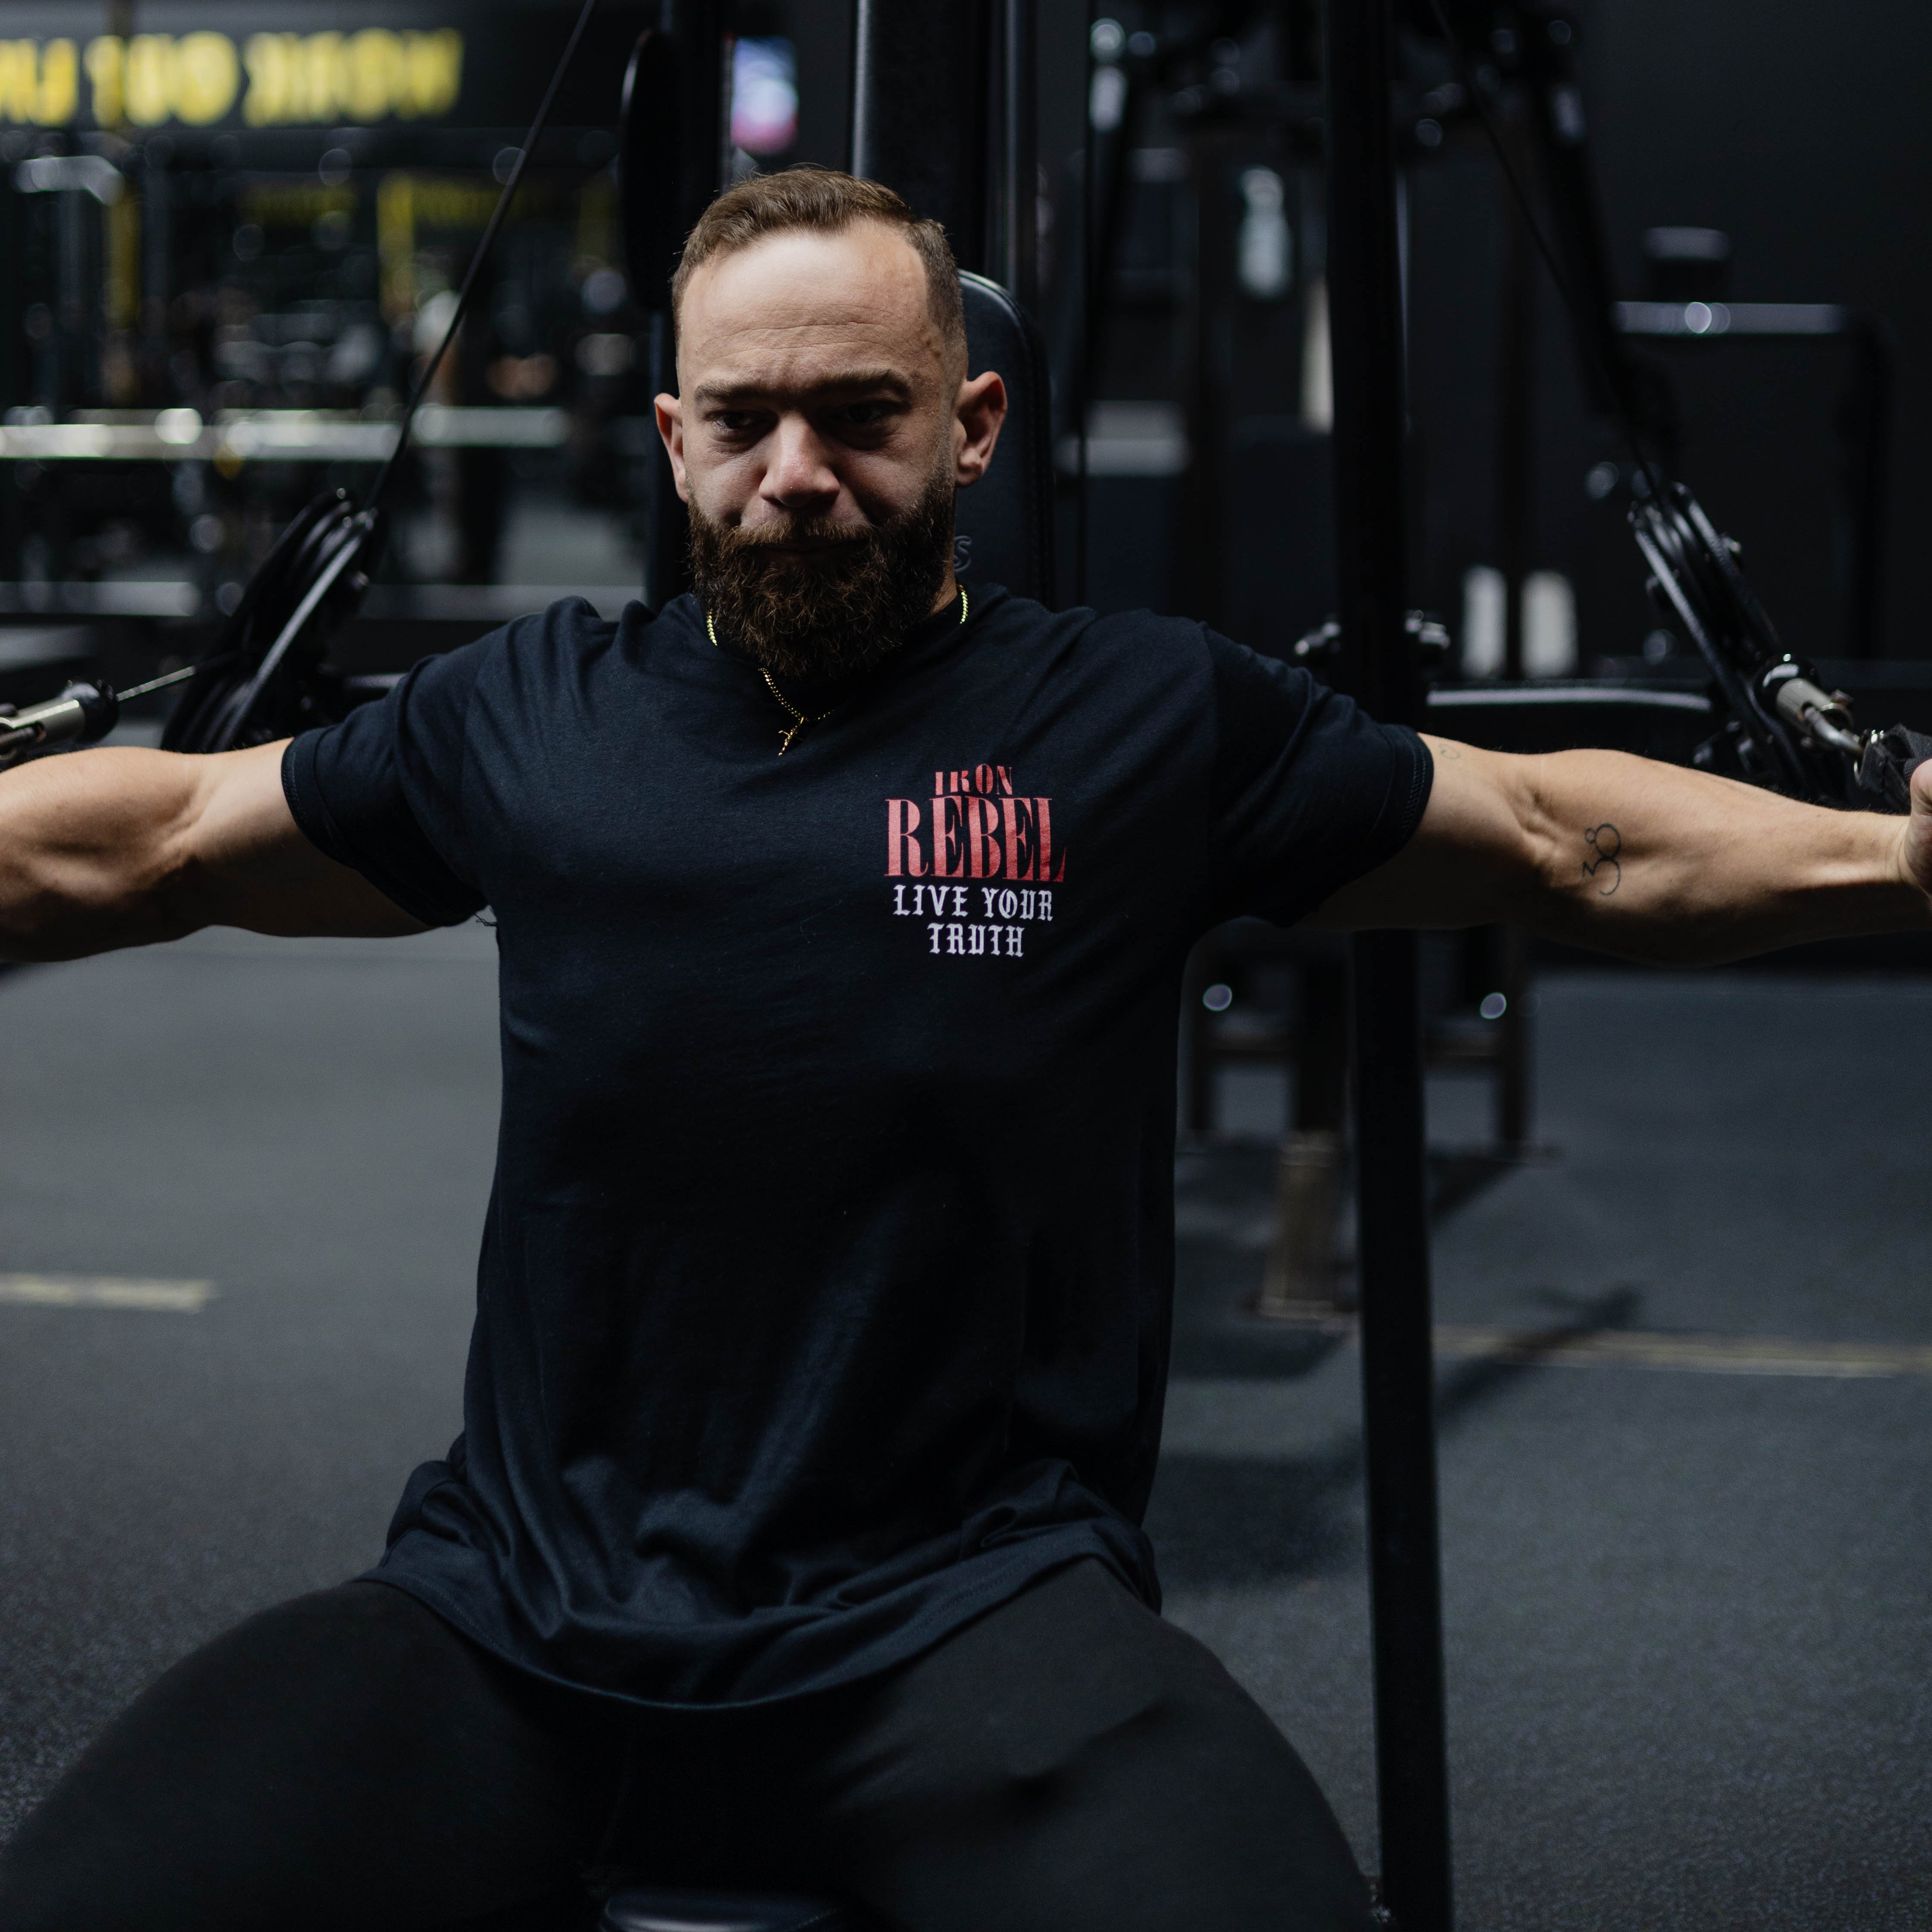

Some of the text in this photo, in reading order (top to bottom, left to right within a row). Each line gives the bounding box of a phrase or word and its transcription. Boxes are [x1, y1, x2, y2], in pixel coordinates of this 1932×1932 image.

[935, 763, 1013, 796] IRON
[884, 795, 1066, 883] REBEL
[892, 884, 1054, 922] LIVE YOUR
[927, 922, 1026, 958] TRUTH
